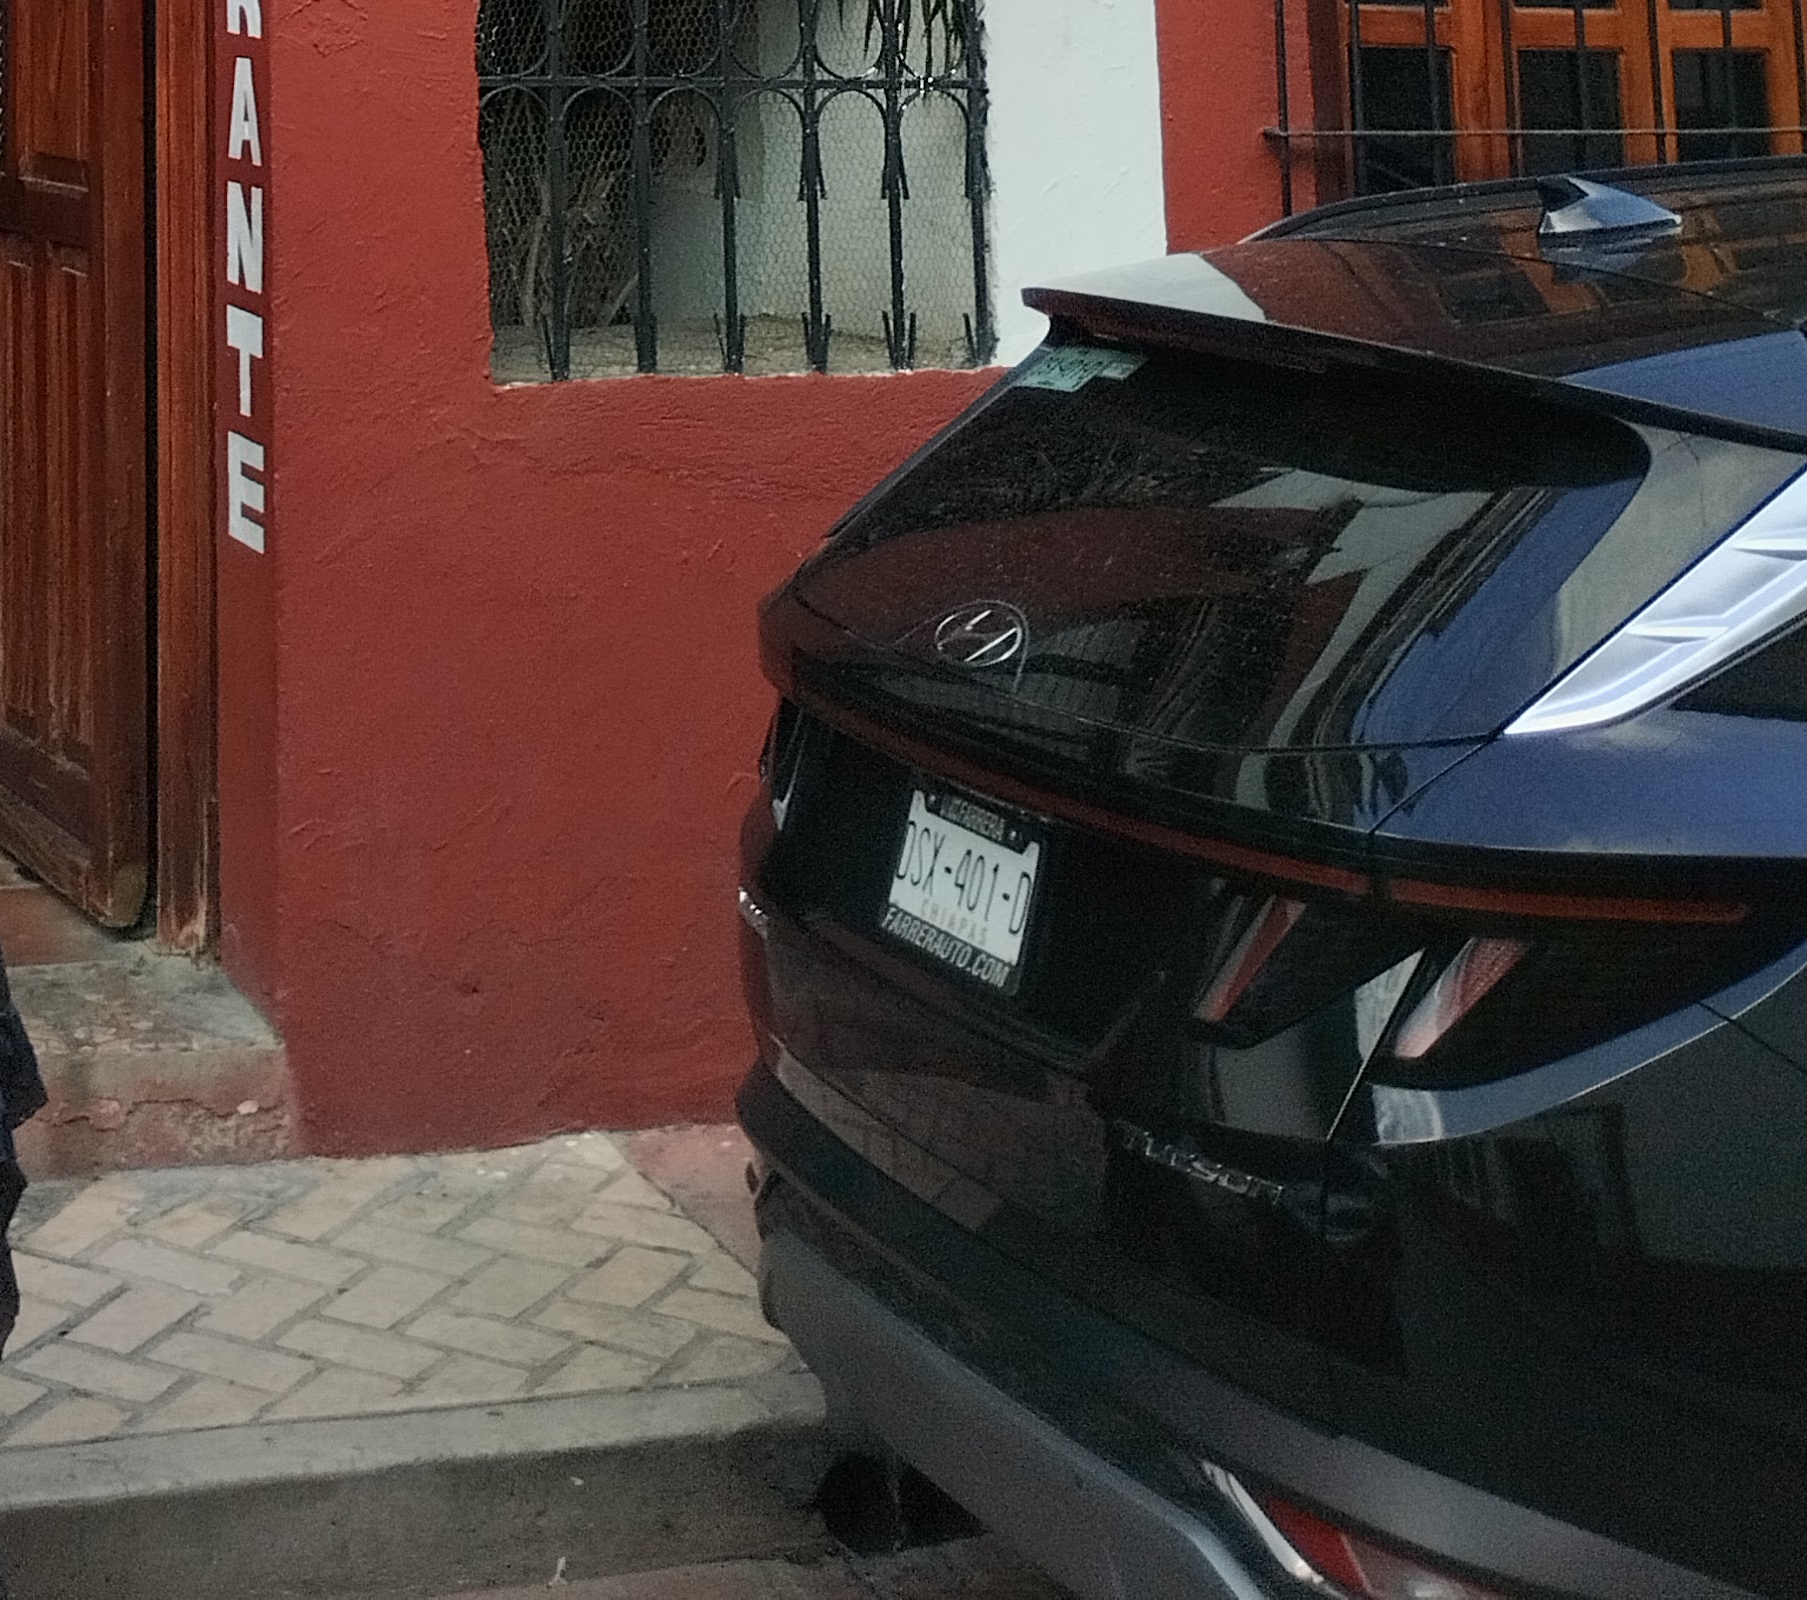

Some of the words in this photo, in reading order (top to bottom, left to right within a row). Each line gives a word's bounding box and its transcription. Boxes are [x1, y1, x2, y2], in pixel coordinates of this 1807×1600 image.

[895, 820, 1032, 935] DSX-401-D
[881, 907, 1010, 988] FARRERAUTO.COM
[920, 897, 989, 946] CHIAPAS
